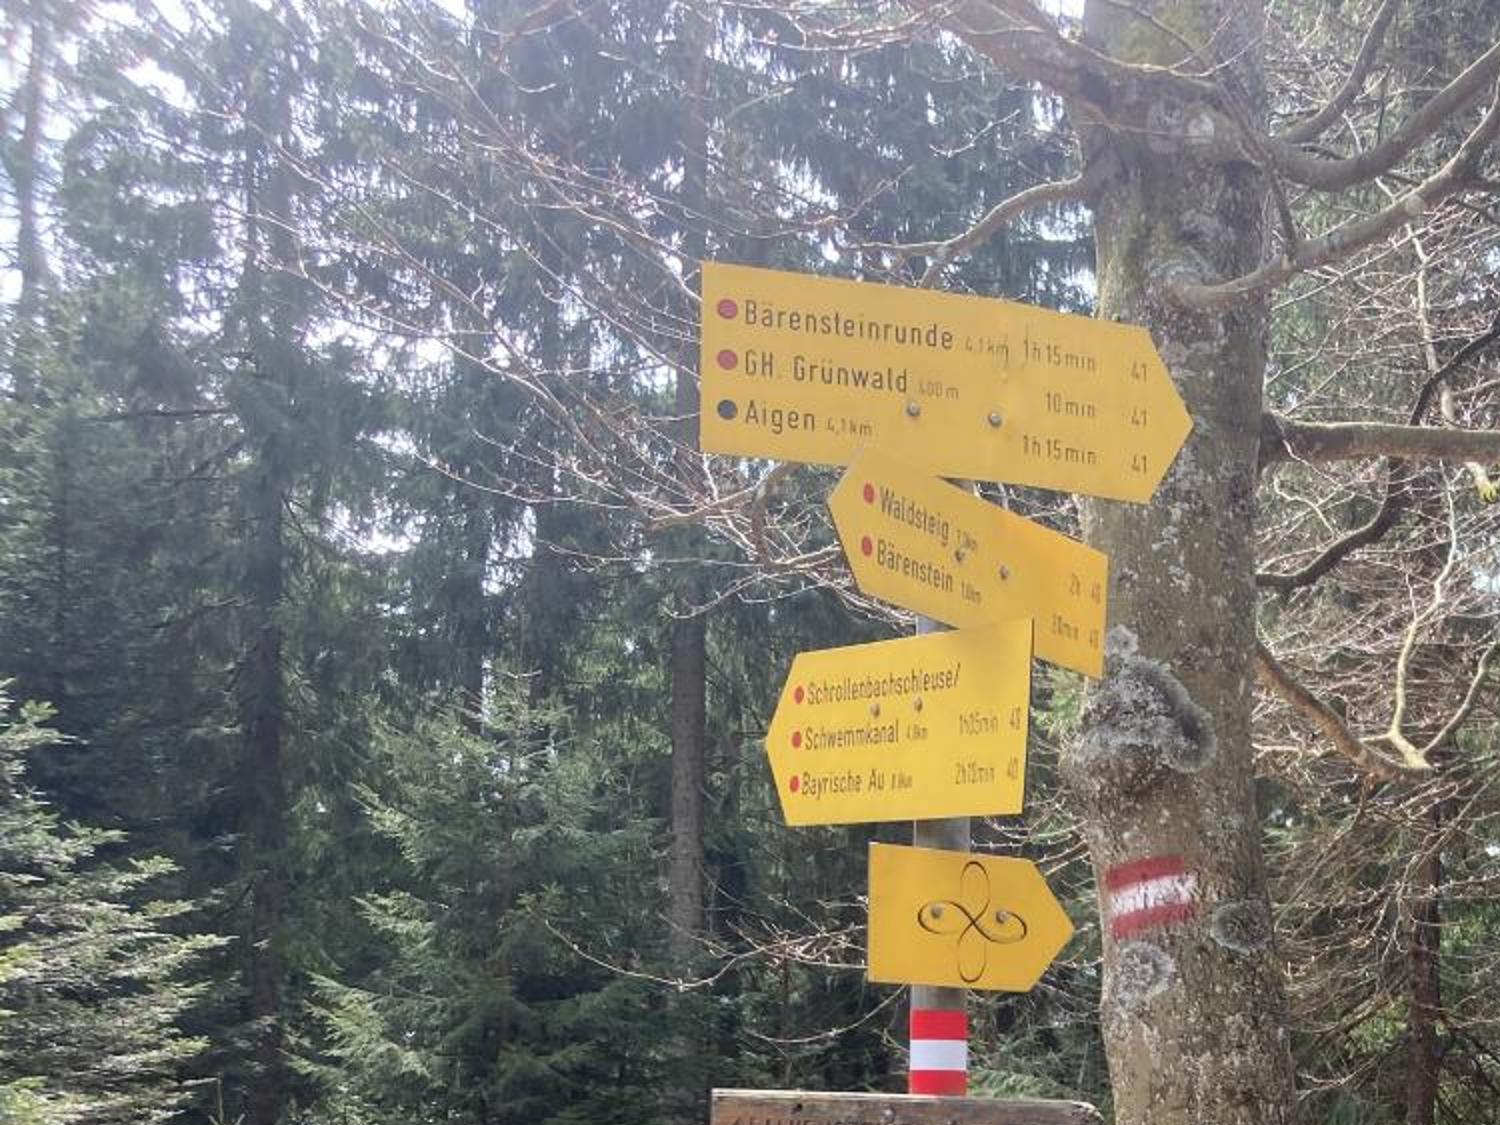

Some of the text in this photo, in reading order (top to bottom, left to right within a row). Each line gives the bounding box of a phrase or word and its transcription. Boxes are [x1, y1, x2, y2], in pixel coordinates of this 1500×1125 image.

[744, 299, 954, 350] Bärensteinrunde
[1130, 361, 1149, 383] 41
[793, 355, 908, 394] Grünwald
[1130, 408, 1149, 427] 41
[744, 400, 817, 435] Aigen
[1130, 455, 1149, 475] 41
[880, 485, 949, 547] Waldsteig
[877, 538, 953, 593] Bärenstein
[804, 719, 899, 751] Schwemmkanal
[801, 769, 862, 801] Bayrische
[868, 767, 885, 791] Au
